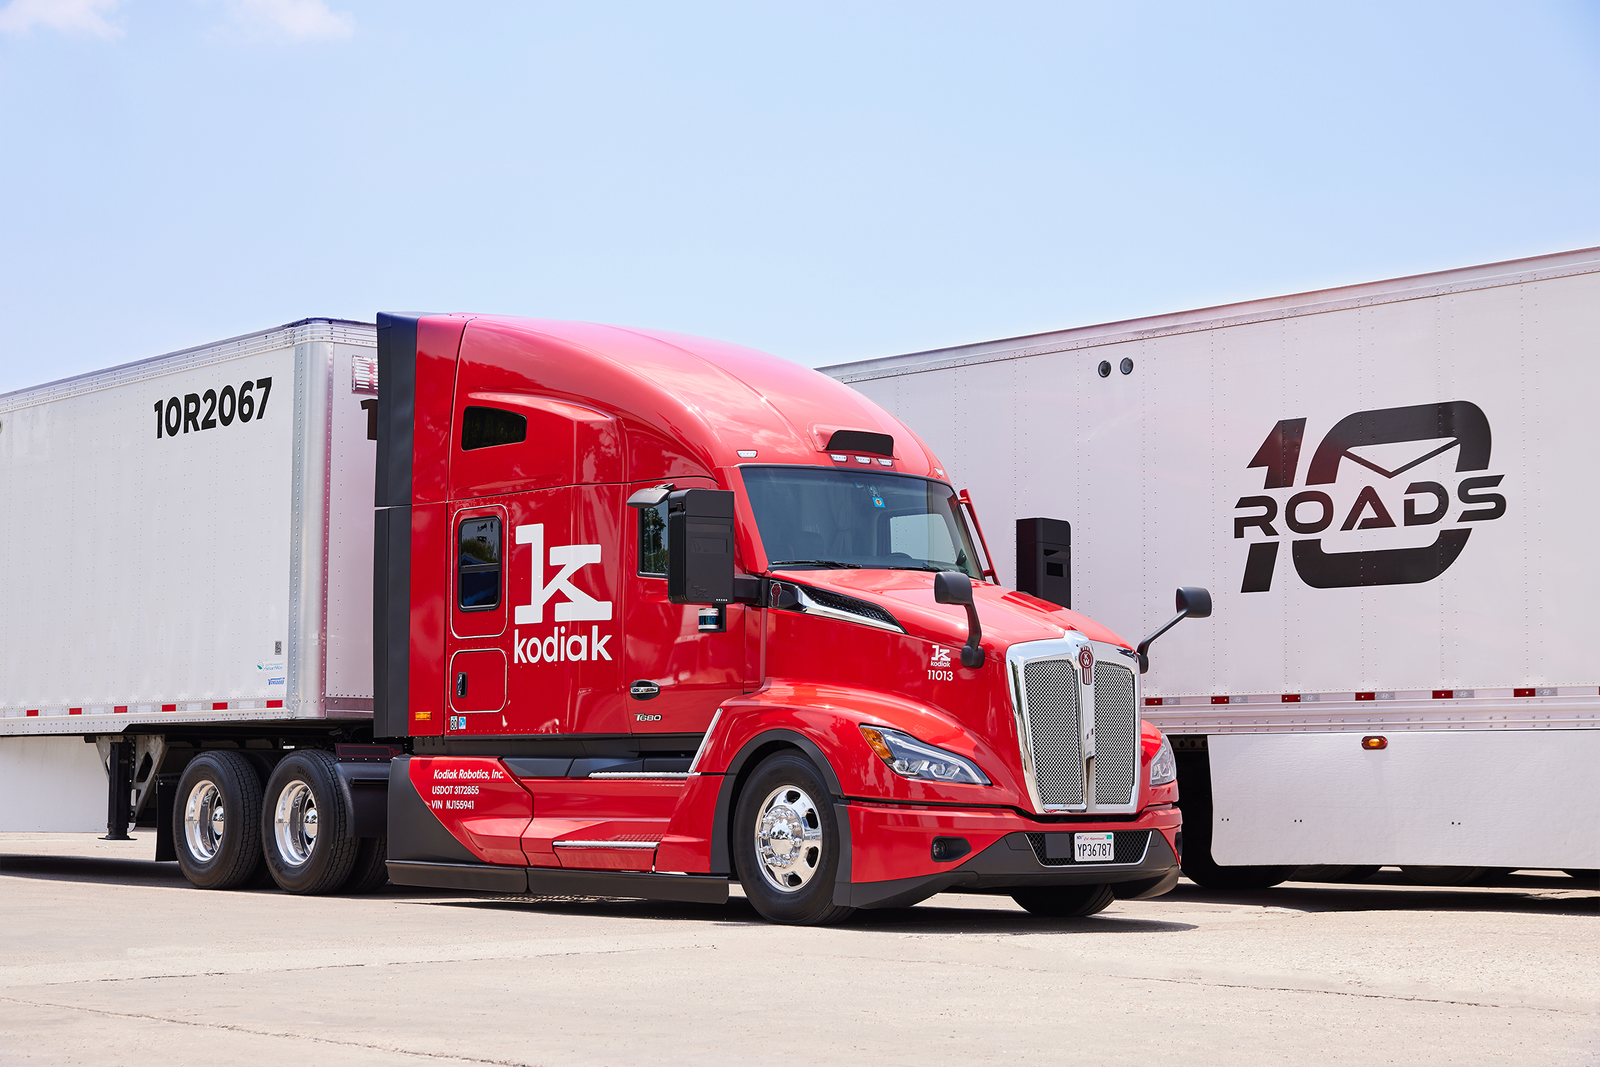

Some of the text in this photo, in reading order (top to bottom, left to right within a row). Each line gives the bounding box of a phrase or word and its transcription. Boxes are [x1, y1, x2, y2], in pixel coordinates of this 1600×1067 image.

[153, 376, 273, 439] 10R2067
[1240, 400, 1492, 593] 10
[1234, 473, 1507, 540] ROADS
[513, 625, 613, 665] kodiak
[930, 660, 951, 668] kodiak
[927, 669, 954, 682] 11013
[634, 712, 662, 722] T680
[433, 768, 504, 781] Kodiak Robotics, Inc.
[431, 785, 480, 795] USDOT 3172855
[431, 799, 443, 810] VIN
[1077, 842, 1112, 857] YP36787
